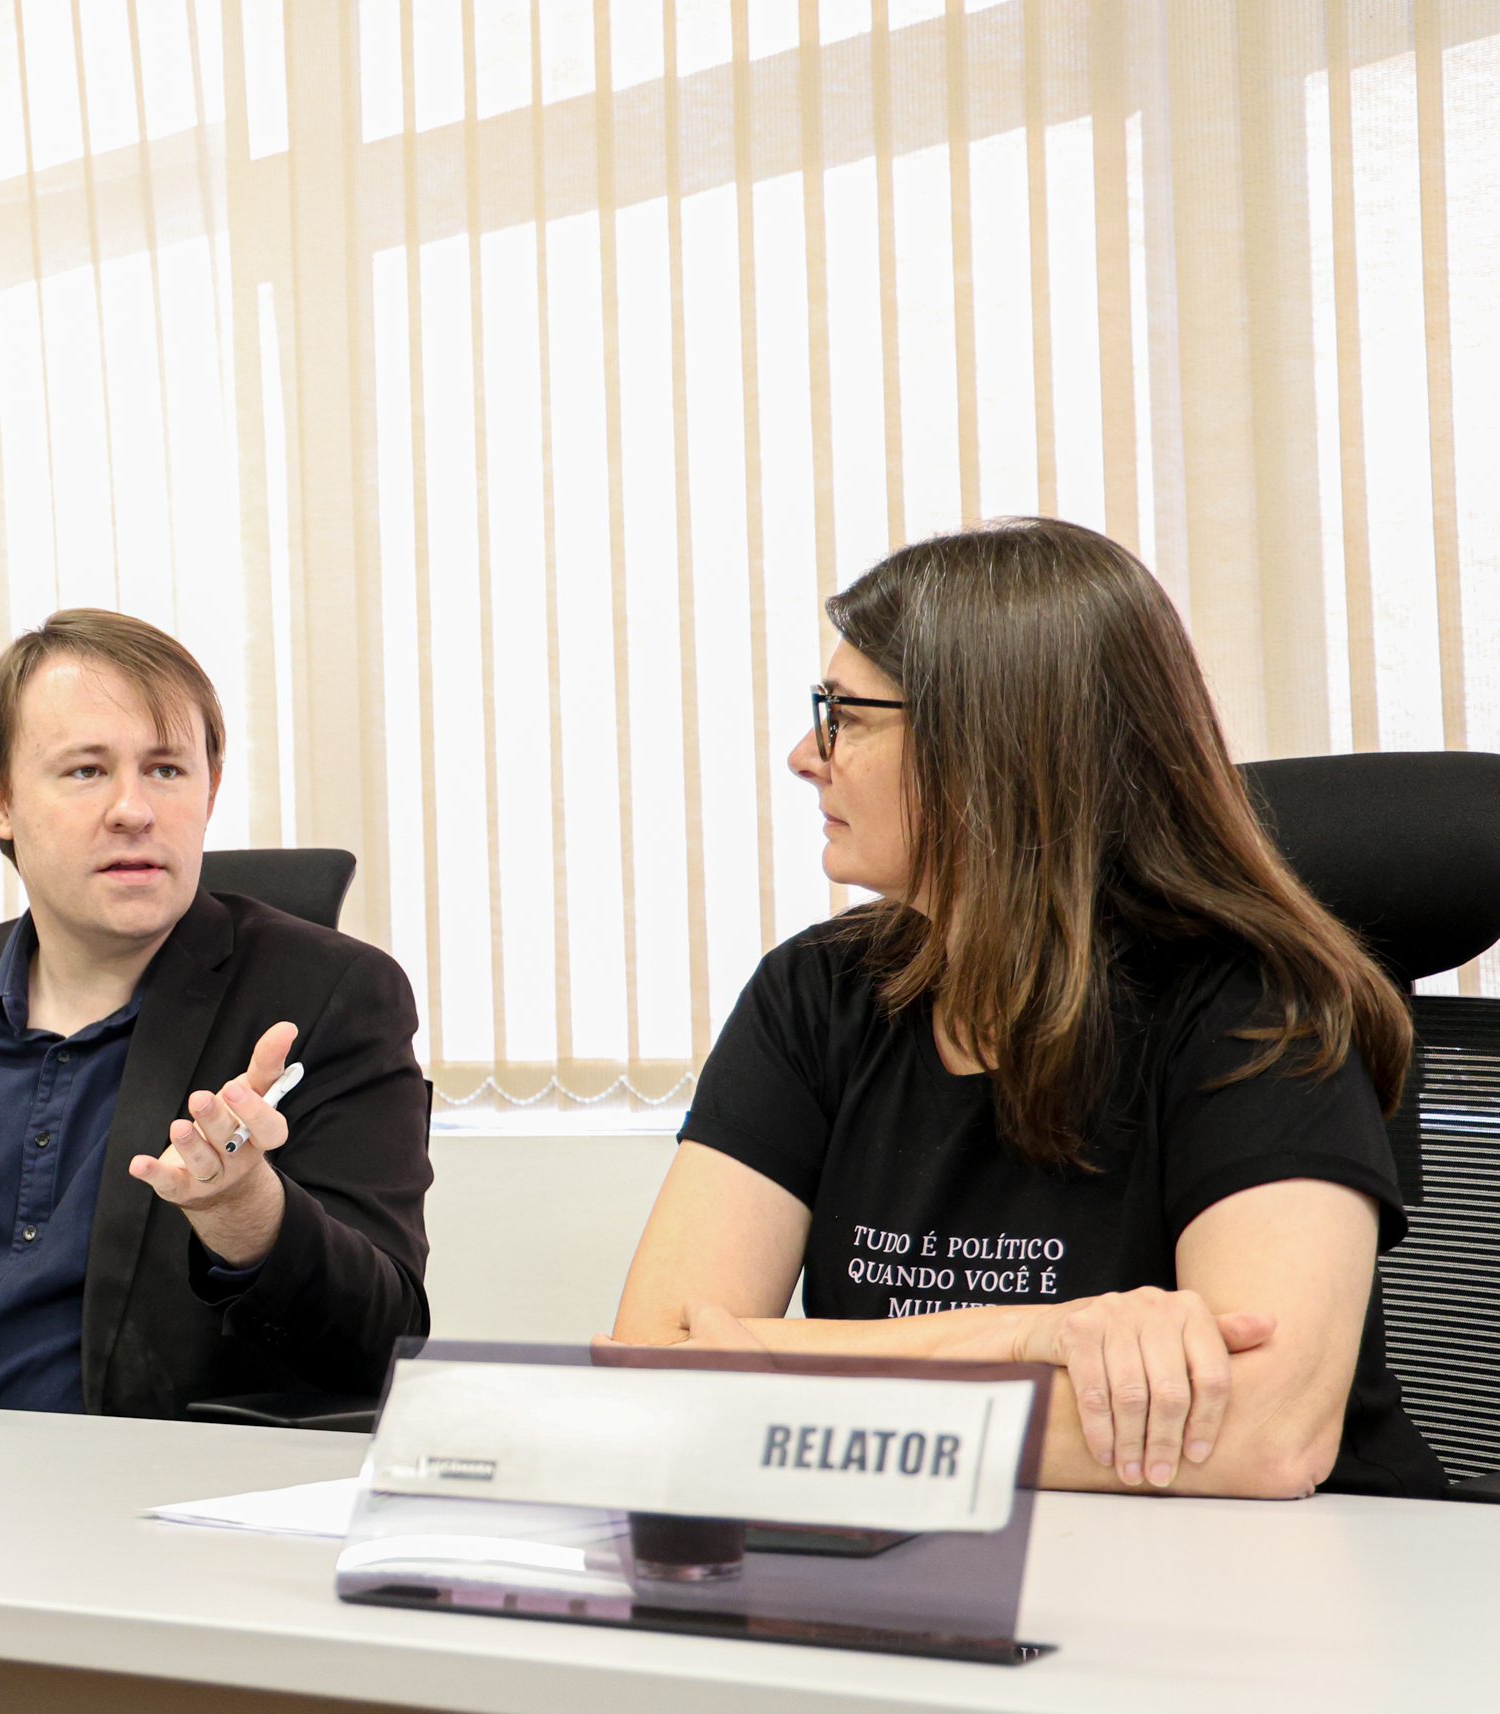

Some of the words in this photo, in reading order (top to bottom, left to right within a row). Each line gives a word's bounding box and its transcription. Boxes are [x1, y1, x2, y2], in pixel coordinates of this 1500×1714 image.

[853, 1225, 910, 1254] TUDO
[920, 1231, 937, 1257] É
[947, 1233, 1064, 1260] POLÍTICO
[848, 1258, 955, 1290] QUANDO
[964, 1267, 1030, 1293] VOCÊ
[1040, 1266, 1057, 1294] É
[761, 1425, 961, 1477] RELATOR
